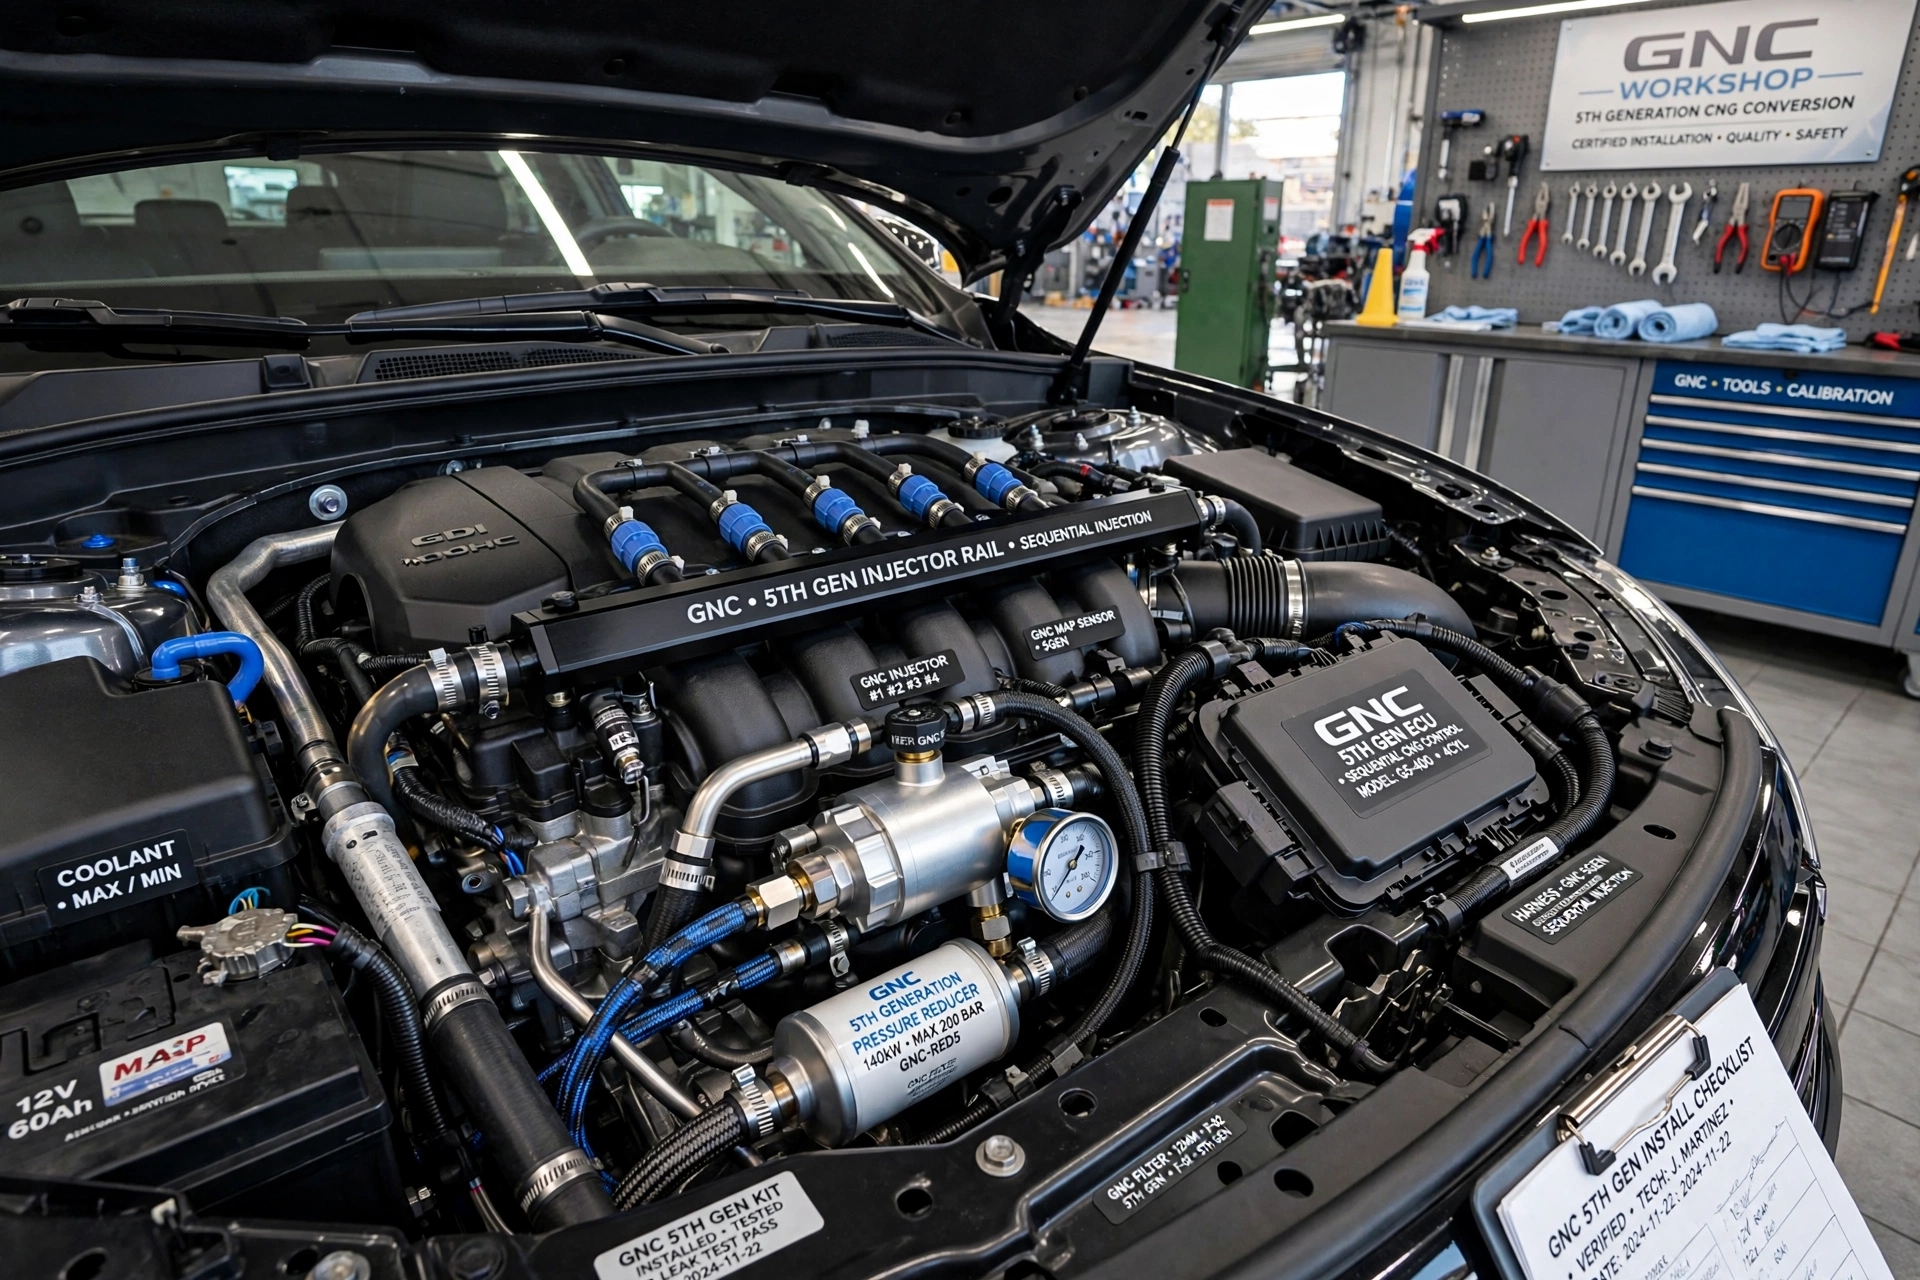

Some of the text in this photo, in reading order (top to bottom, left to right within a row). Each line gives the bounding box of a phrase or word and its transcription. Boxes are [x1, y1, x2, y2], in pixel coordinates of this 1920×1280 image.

[1624, 18, 1819, 72] GNC
[1575, 95, 1855, 124] 5TH GENERATION CNG CONVERSION
[1620, 68, 1813, 100] WORKSHOP
[1572, 127, 1848, 150] CERTIFIED INSTALLATION QUALITY SAFETY
[1674, 373, 1894, 405] GNC TOOLS CALIBRATION
[411, 523, 488, 547] GDI
[687, 509, 1153, 625] GNC 5TH GEN INJECTOR RAIL SEQUENTIAL INJECTION
[1030, 610, 1116, 640] GNC MAP SENSOR
[860, 655, 949, 688] GNC INJECTOR
[869, 672, 940, 702] #1 #2 #3 #4
[1313, 685, 1424, 747] GNC
[1337, 712, 1438, 767] 5TH GEN ECU
[1344, 722, 1464, 784] SEQUENTIAL CNG CONTROL
[1355, 773, 1399, 799] MODEL:
[1442, 738, 1470, 758] 4CYL
[57, 839, 175, 888] COOLANT
[72, 880, 124, 910] MAX
[140, 863, 182, 889] MIN
[849, 971, 963, 1033] 5TH GENERATION
[868, 970, 922, 1002] GNC
[852, 982, 981, 1056] PRESSURE REDUCER
[863, 1041, 902, 1071] 140kW
[911, 1022, 940, 1047] MAX
[939, 1013, 960, 1035] 200
[961, 1000, 986, 1022] BAR
[900, 1030, 962, 1073] GNC-RED5
[7, 1099, 94, 1140] 60Ah
[16, 1079, 78, 1115] 12V
[1548, 1036, 1756, 1258] GNC 5TH GEN INSTALL CHECKLIST
[1107, 1176, 1136, 1200] GNC
[1131, 1152, 1171, 1183] FILTER
[1576, 1212, 1627, 1273] VERIFIED
[1636, 1168, 1671, 1209] TECH:
[1671, 1156, 1682, 1175] J.
[1679, 1105, 1730, 1160] MARTINEZ
[618, 1182, 782, 1267] GNC 5TH GEN KIT
[1591, 1255, 1622, 1280] ATE:
[1680, 1130, 1732, 1197] 2024-11-22
[636, 1201, 784, 1277] INSTALLED TESTED
[660, 1218, 779, 1280] LEAK TEST PASS
